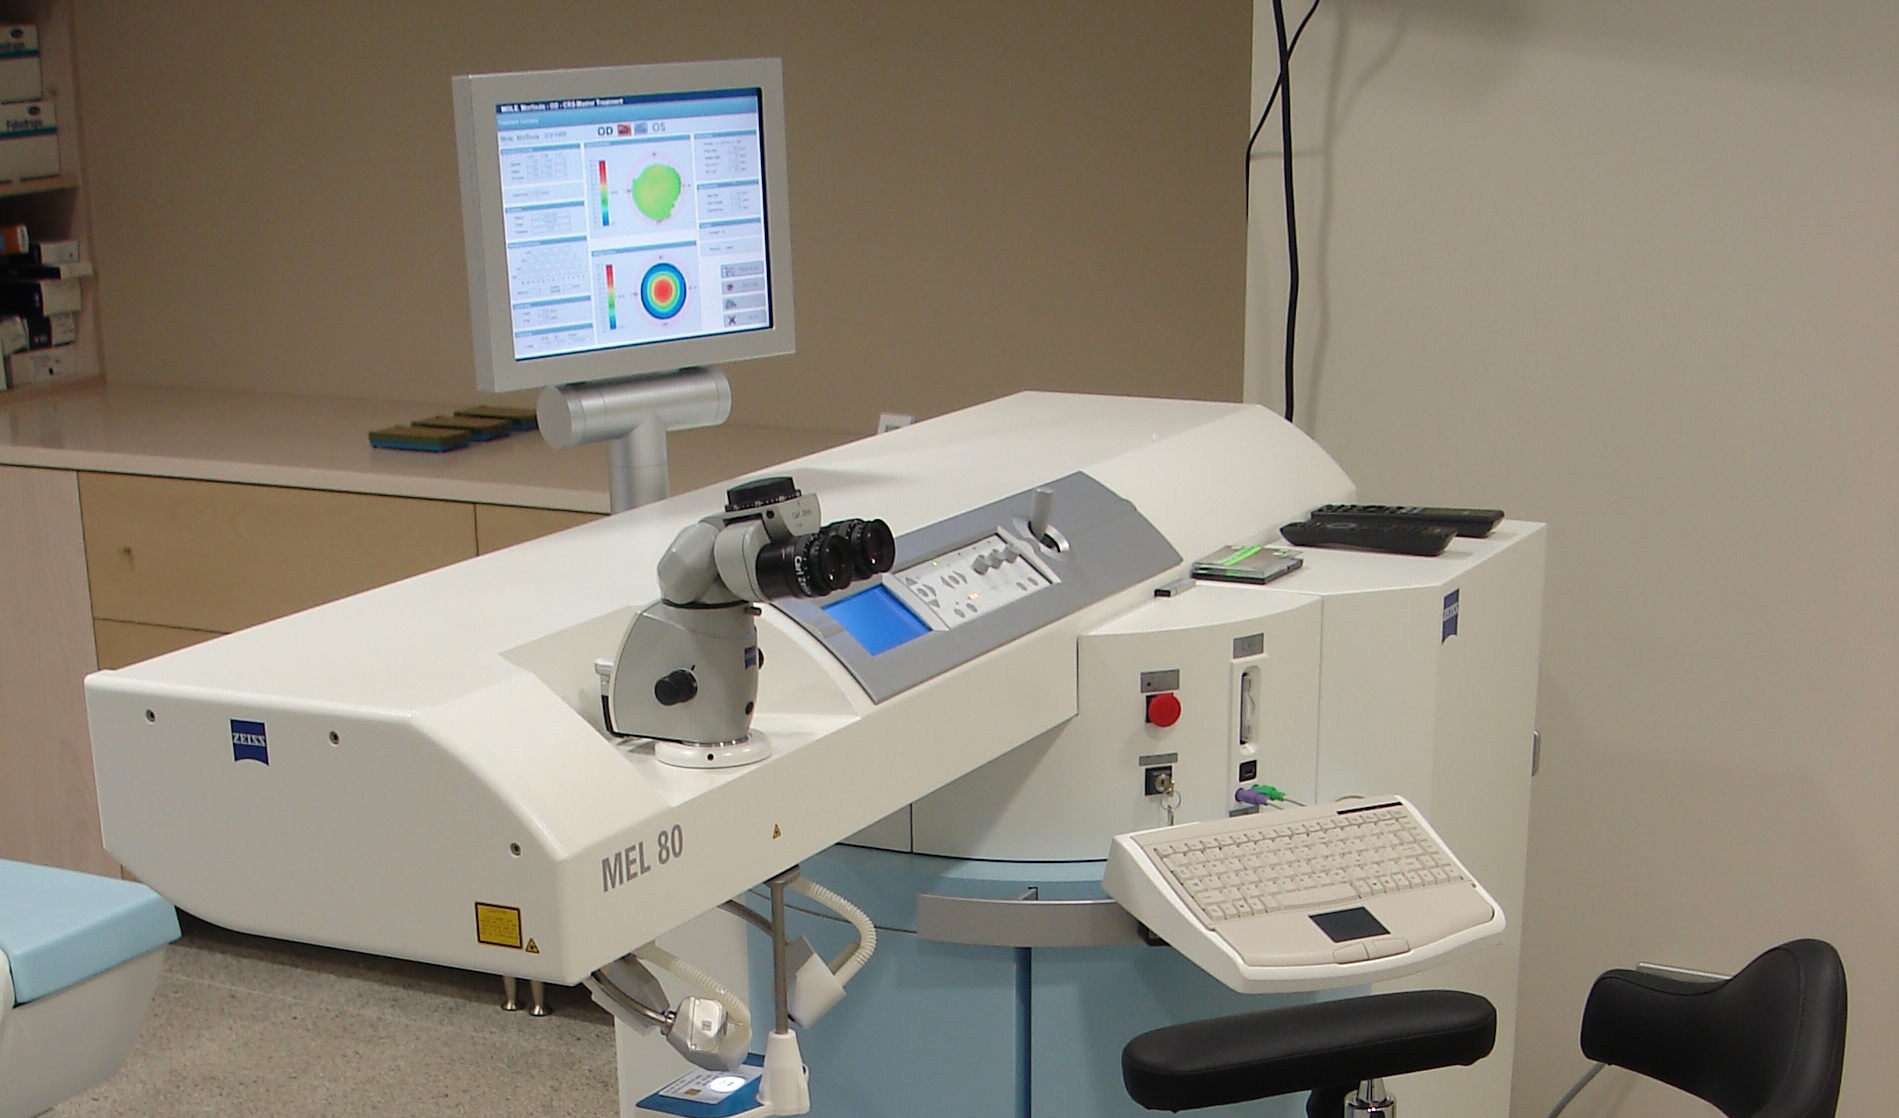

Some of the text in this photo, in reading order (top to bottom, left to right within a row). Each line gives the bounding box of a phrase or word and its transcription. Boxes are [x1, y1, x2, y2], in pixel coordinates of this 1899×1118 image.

[597, 126, 614, 136] OD
[652, 122, 666, 132] OS
[794, 555, 804, 576] Carl
[232, 732, 266, 747] ZEISS
[602, 824, 683, 893] MEL 80
